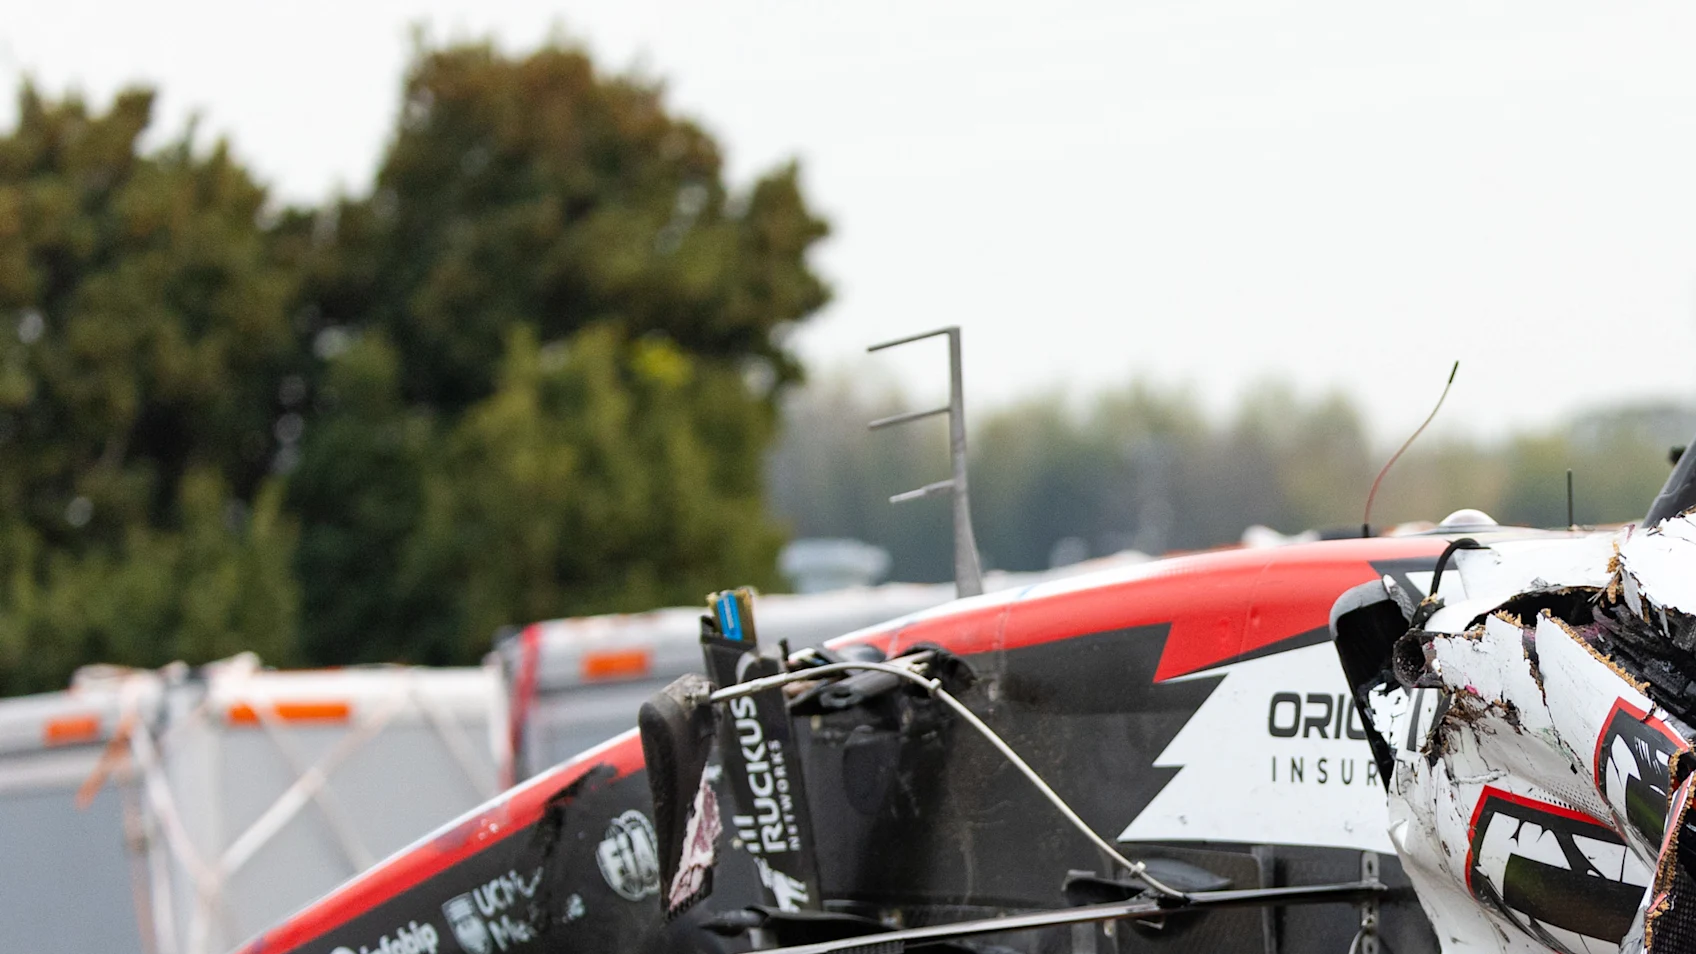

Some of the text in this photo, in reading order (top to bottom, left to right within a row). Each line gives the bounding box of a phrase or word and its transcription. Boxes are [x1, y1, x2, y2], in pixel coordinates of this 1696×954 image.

[730, 696, 788, 852] RUCKUS
[768, 740, 799, 850] NETWORKS
[1271, 755, 1379, 786] INSUR
